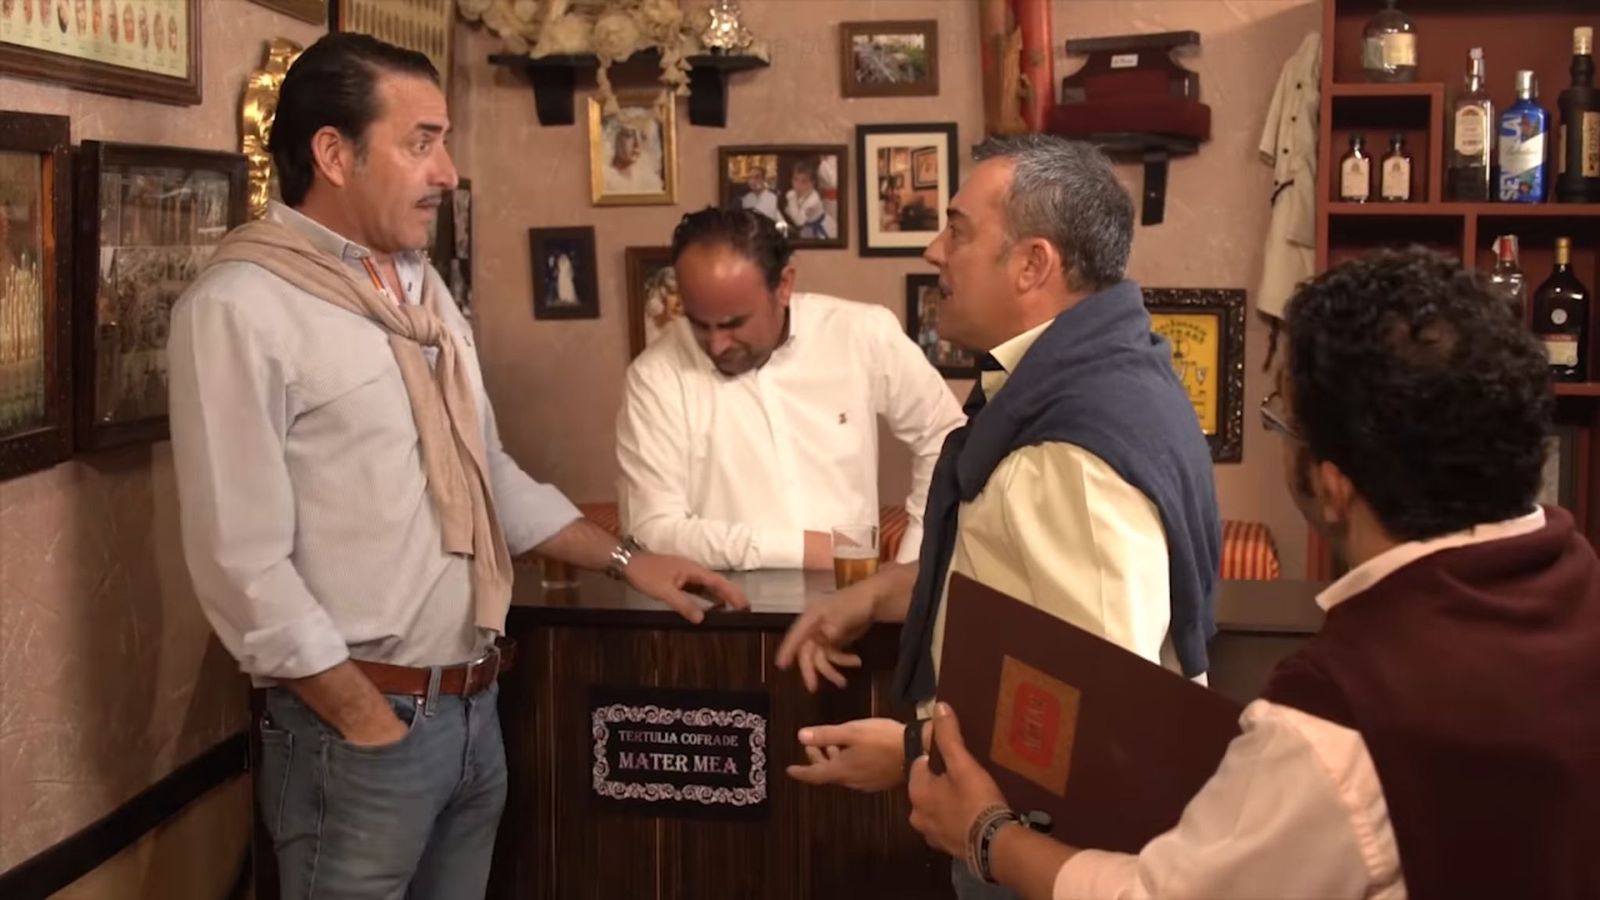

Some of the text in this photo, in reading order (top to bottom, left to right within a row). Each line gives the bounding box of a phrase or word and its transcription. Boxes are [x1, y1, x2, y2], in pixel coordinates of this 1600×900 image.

[618, 730, 738, 746] TERTULIA COFRADE
[618, 751, 738, 774] MATER MEA
